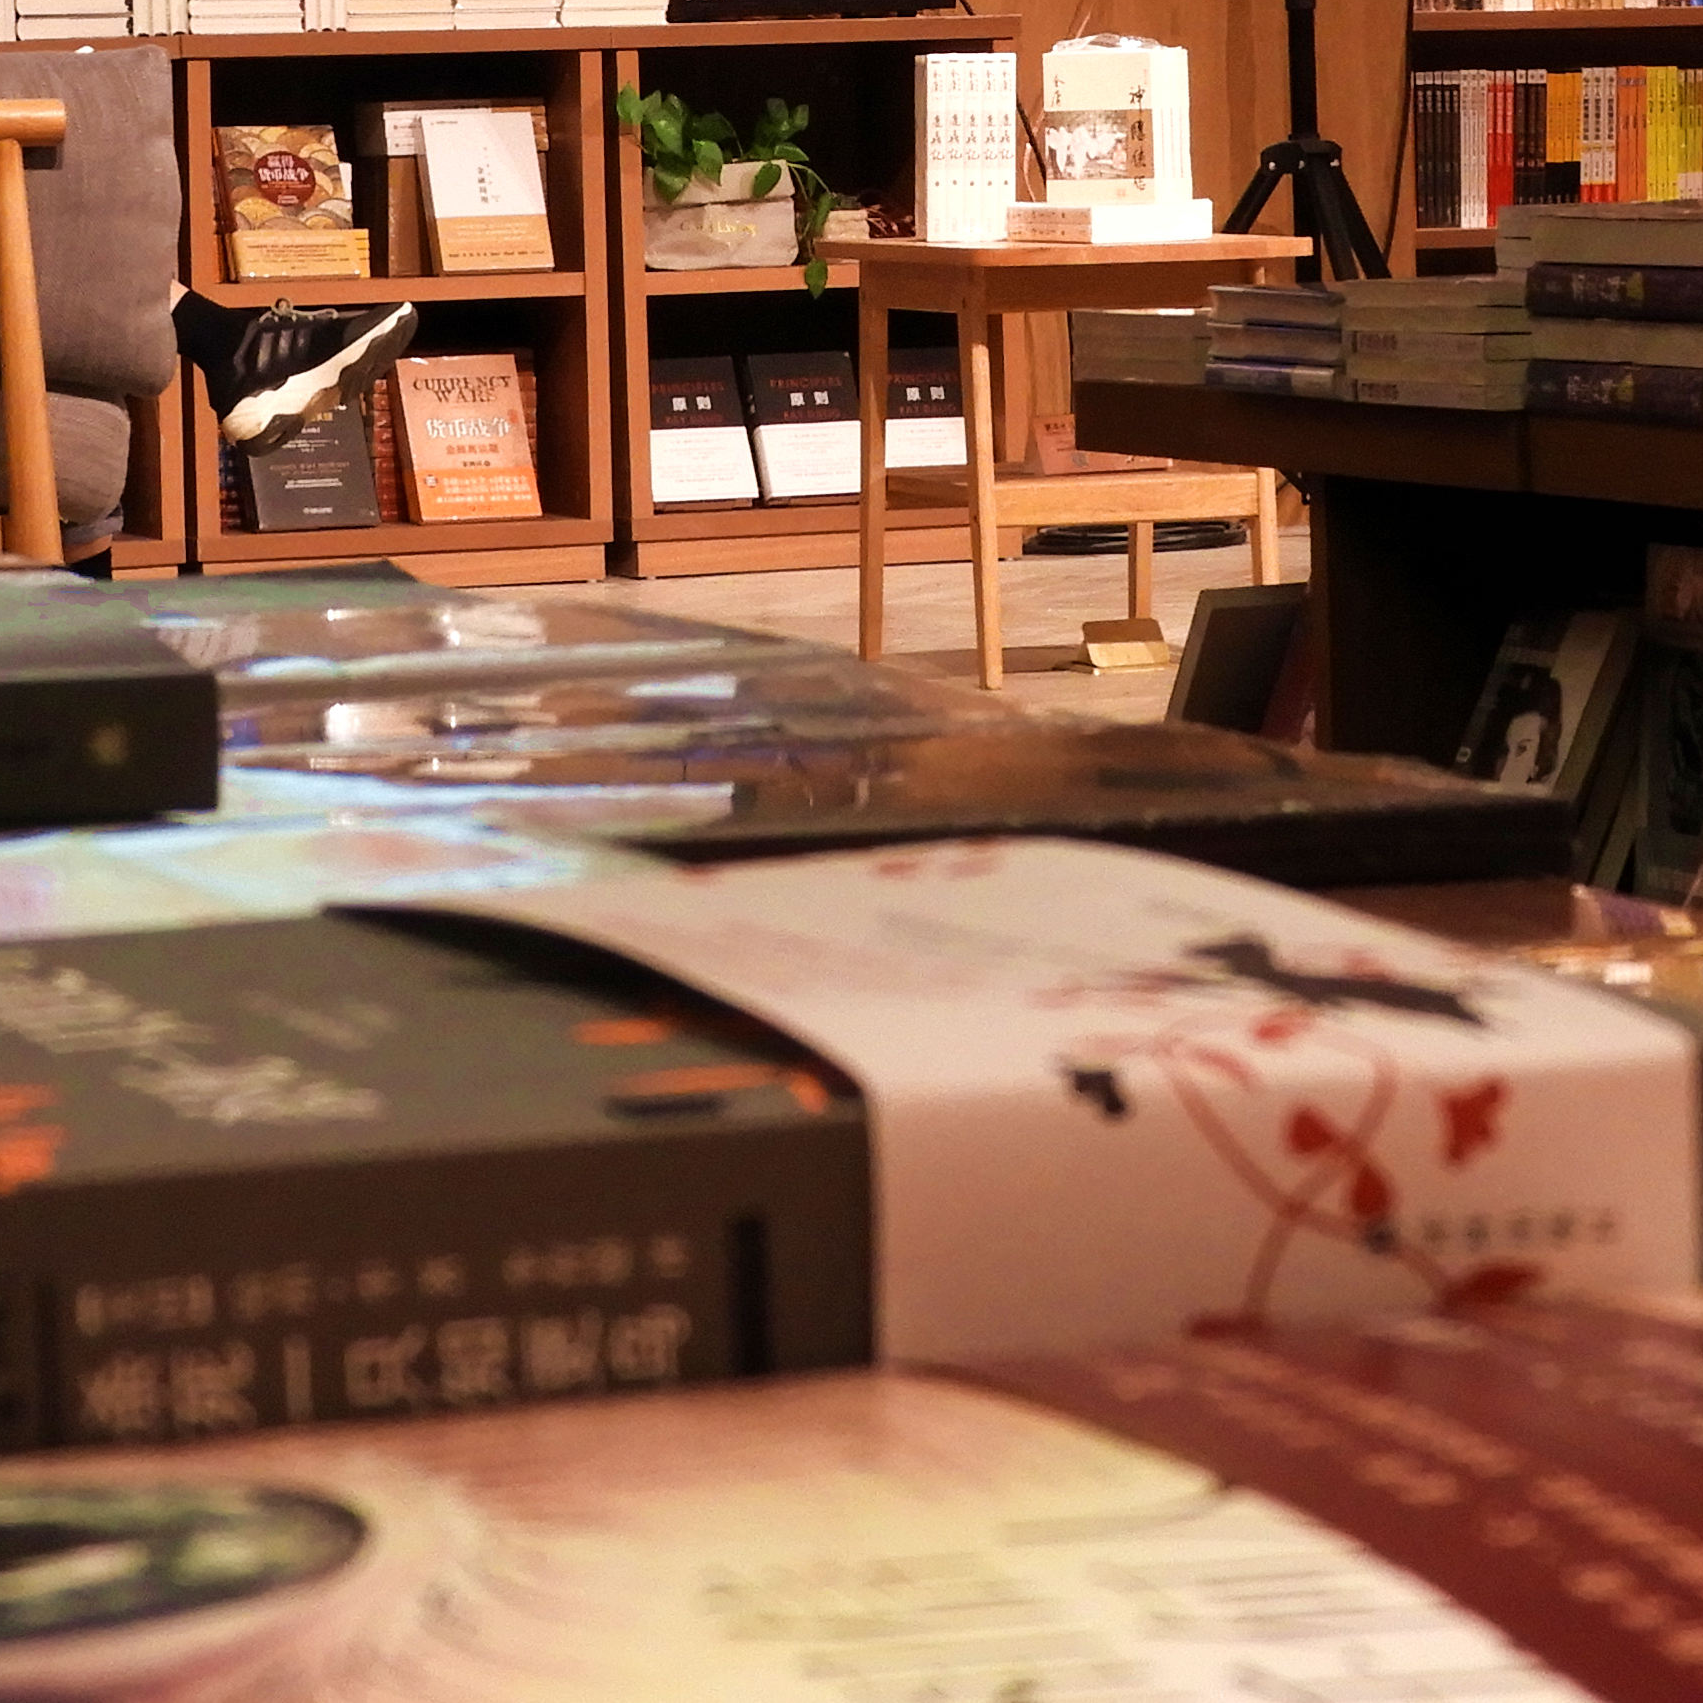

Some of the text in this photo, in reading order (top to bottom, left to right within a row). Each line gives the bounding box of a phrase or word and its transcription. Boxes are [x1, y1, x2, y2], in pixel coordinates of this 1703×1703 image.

[412, 375, 512, 391] CURRENCY
[433, 387, 498, 403] WARS
[425, 417, 511, 439] 货币战争
